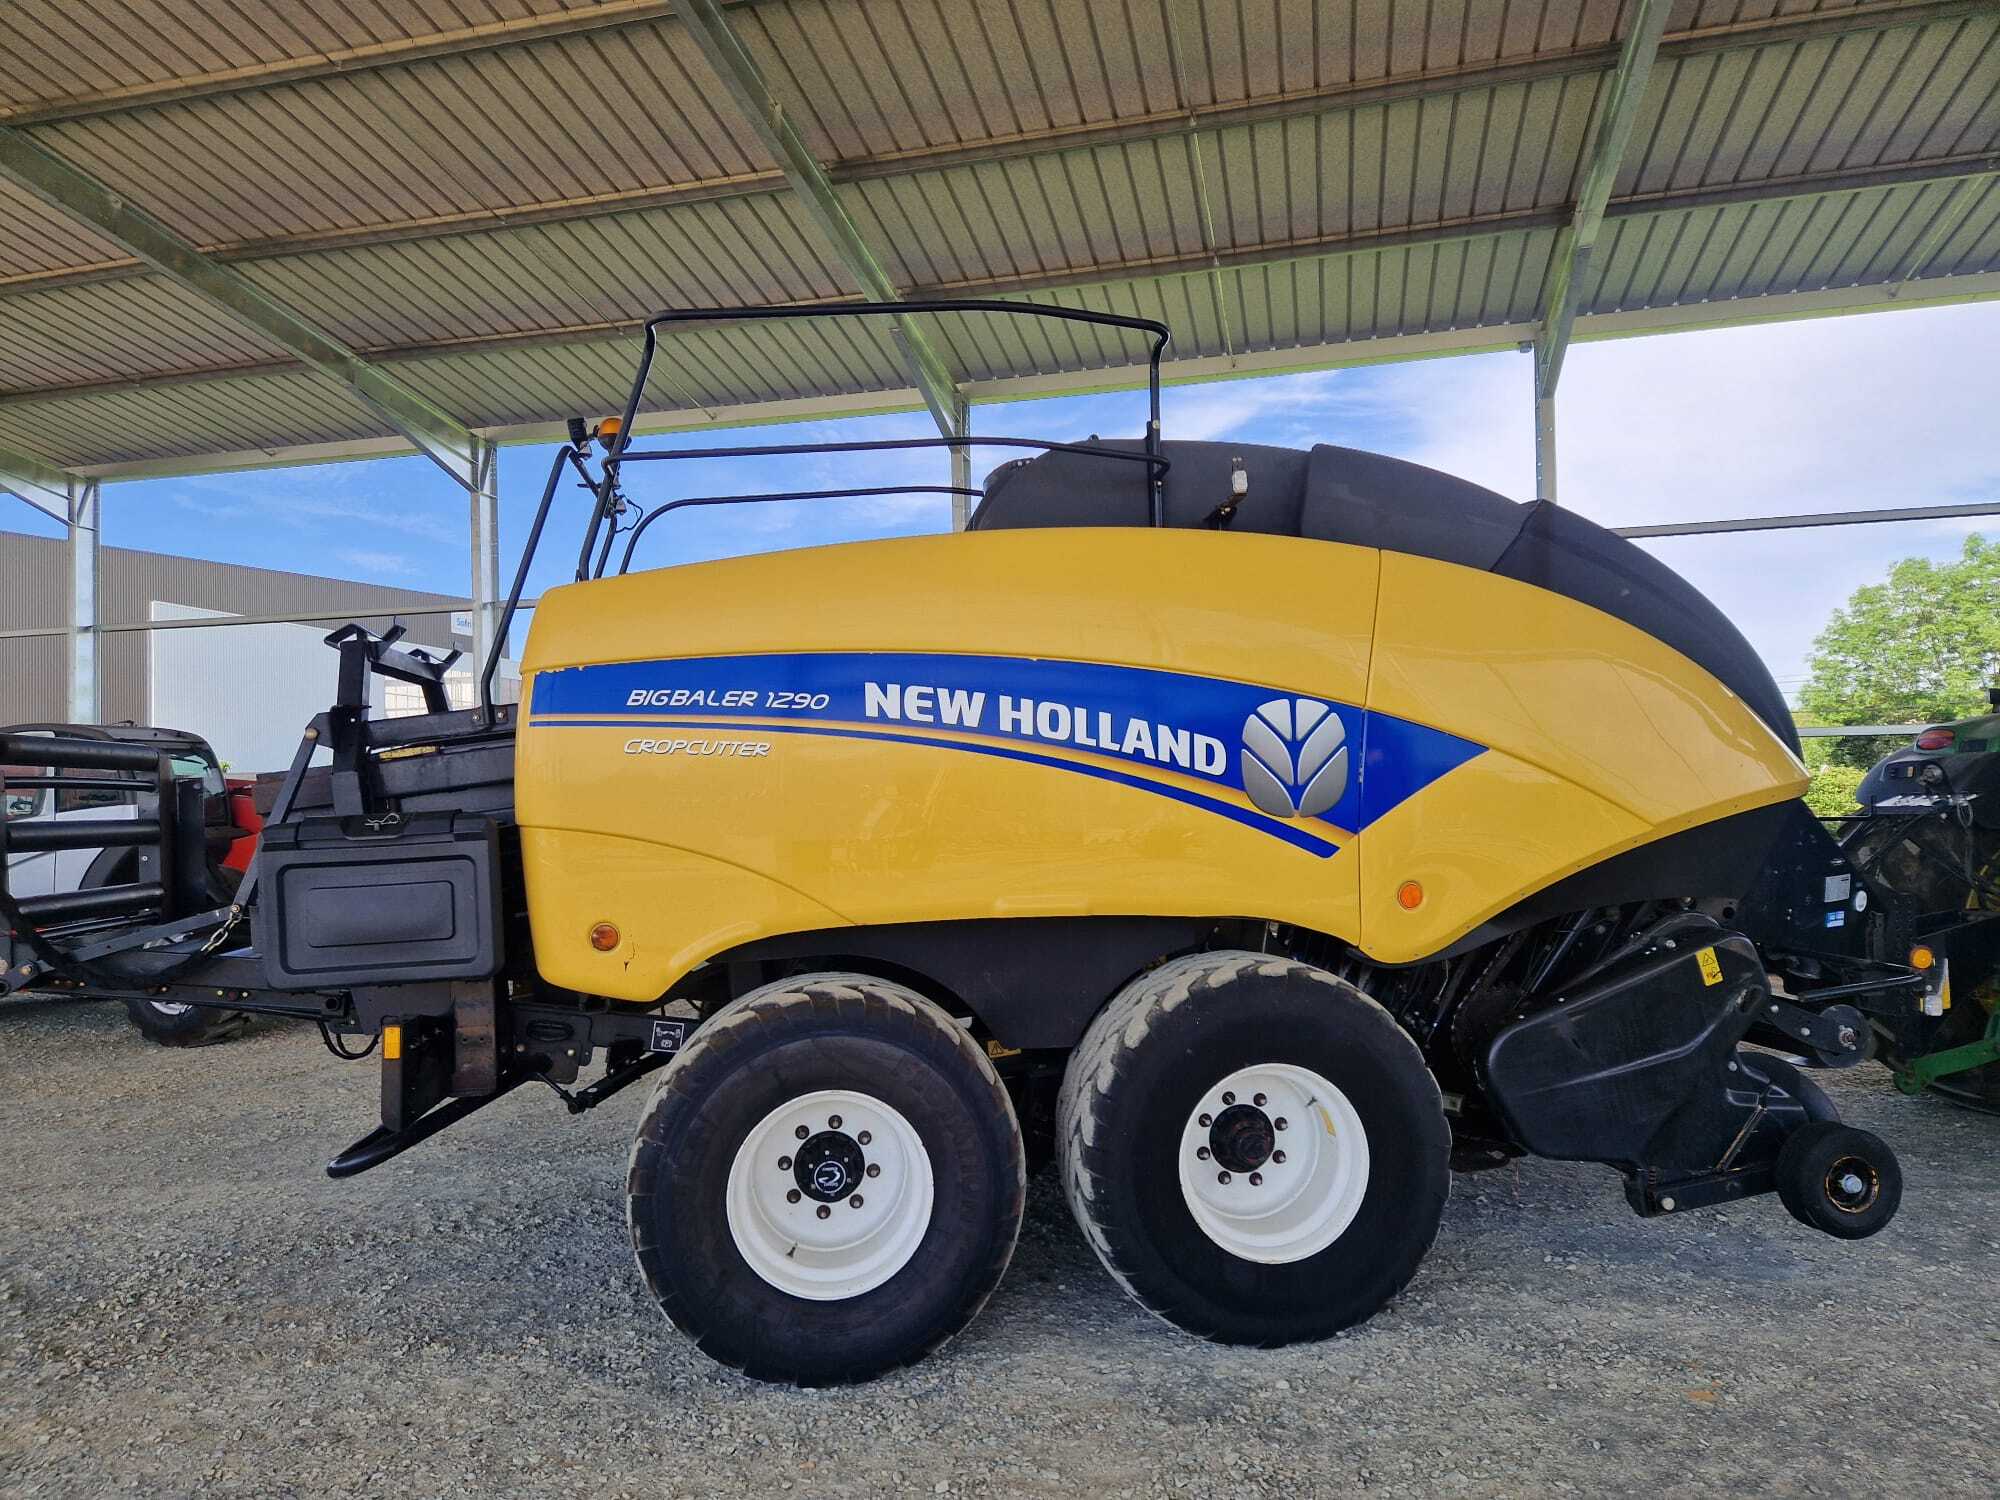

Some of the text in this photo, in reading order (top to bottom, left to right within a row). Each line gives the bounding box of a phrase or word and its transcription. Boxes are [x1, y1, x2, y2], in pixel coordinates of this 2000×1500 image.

[626, 689, 830, 710] BIGBALER 1290
[864, 681, 1227, 776] NEW HOLLAND
[624, 738, 771, 757] CROPCUTTER
